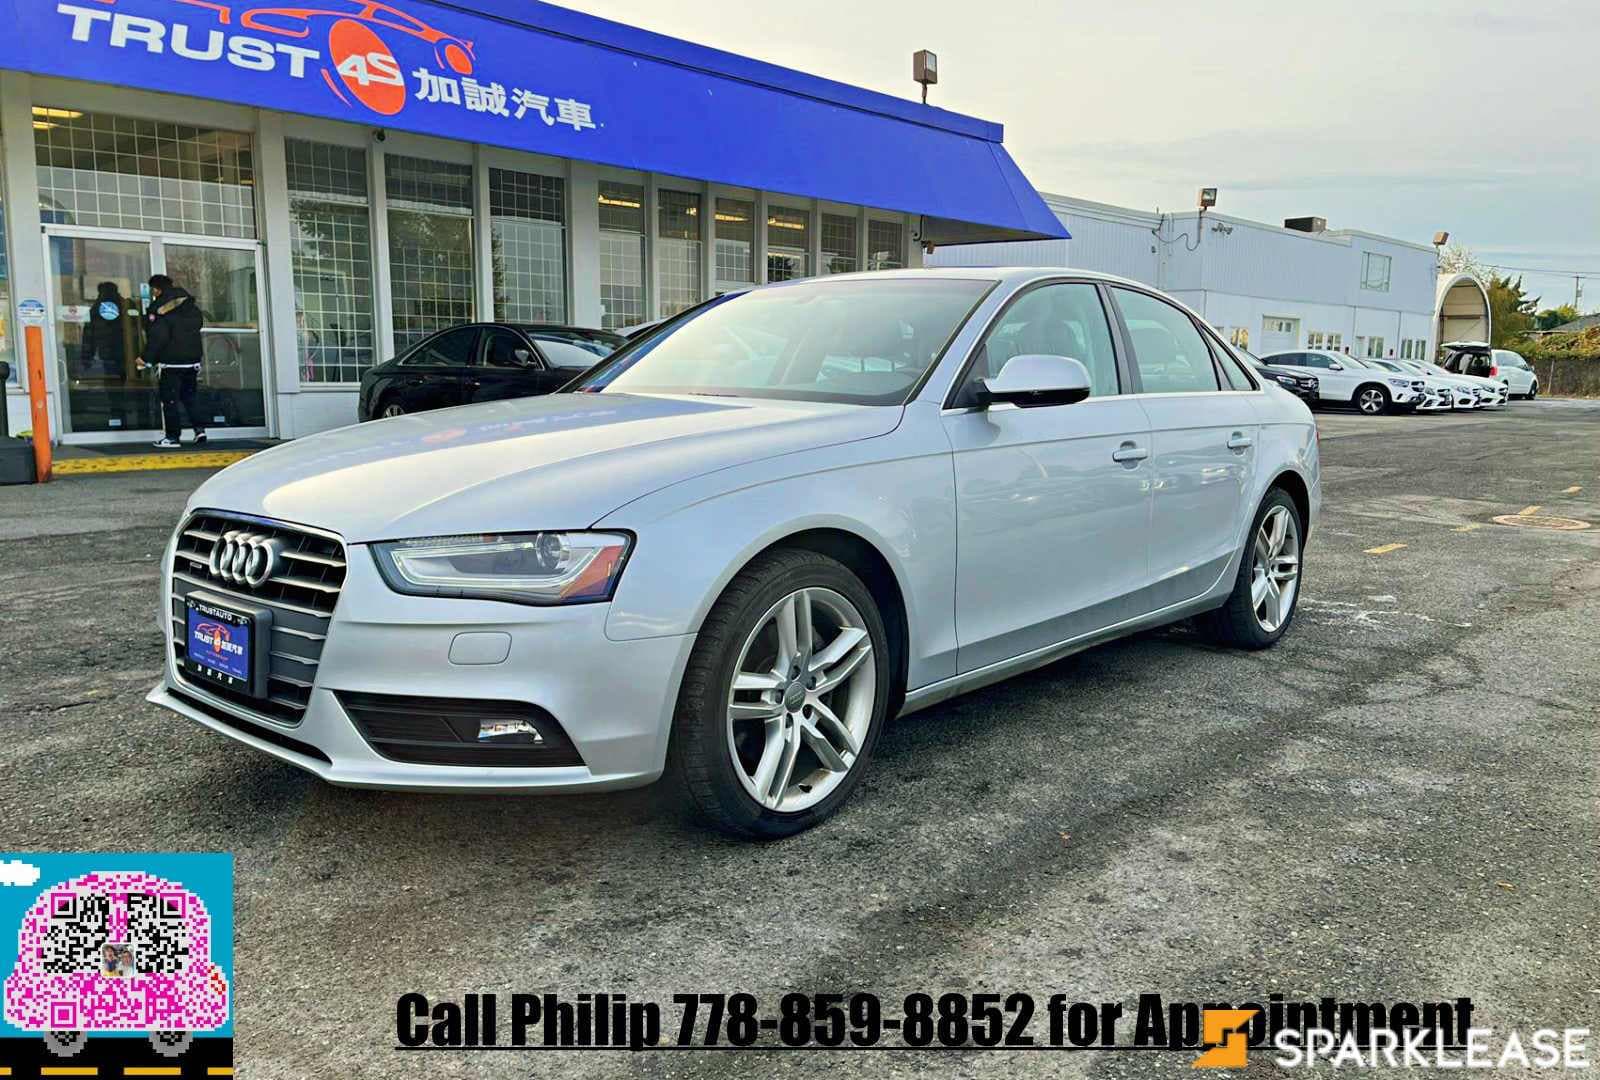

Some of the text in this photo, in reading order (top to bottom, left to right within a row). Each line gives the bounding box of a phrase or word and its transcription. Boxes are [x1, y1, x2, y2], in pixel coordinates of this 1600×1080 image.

[57, 3, 596, 131] TRUST 4S 加誠汽車
[199, 604, 233, 621] TRUSTAUTO
